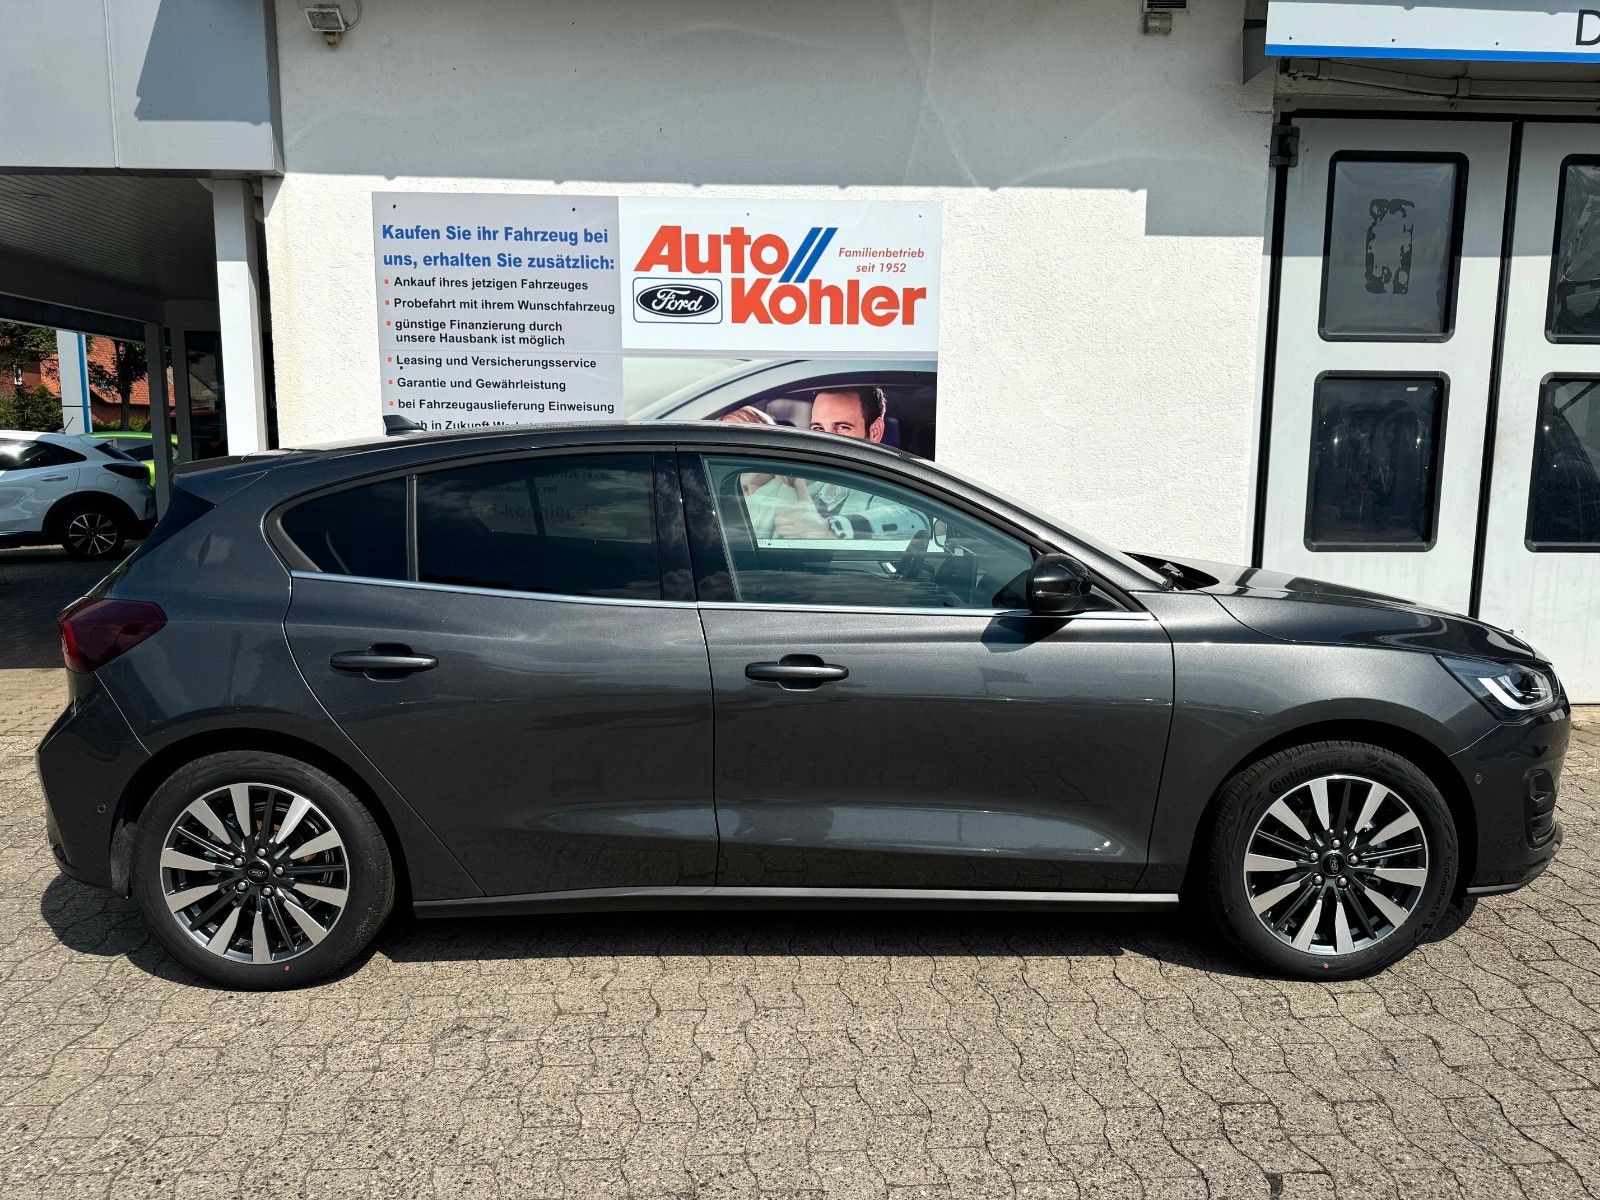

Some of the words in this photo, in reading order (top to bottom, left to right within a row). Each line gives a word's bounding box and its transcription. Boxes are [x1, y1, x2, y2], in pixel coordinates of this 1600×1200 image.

[382, 225, 440, 239] Kaufen
[446, 226, 471, 240] Sie
[478, 226, 499, 240] ihr
[504, 227, 578, 246] Fahrzeug
[584, 229, 607, 243] bei
[633, 225, 789, 275] Auto
[838, 247, 925, 259] Familienbetrieb
[384, 255, 417, 269] uns,
[423, 252, 491, 266] erhalten
[497, 253, 522, 267] Sie
[528, 255, 614, 269] zusätzlich:
[856, 262, 876, 273] seit
[879, 263, 907, 274] 1952
[394, 277, 435, 286] Ankauf
[440, 277, 468, 287] ihres
[472, 278, 517, 290] jetzigen
[521, 279, 588, 292] Fahrzeuges
[394, 298, 456, 308] Probefahrt
[460, 299, 477, 309] mit
[482, 300, 514, 309] ihrem
[518, 300, 614, 314] Wunschfahrzeug
[651, 287, 703, 312] Ford
[395, 319, 446, 331] günstige
[450, 320, 525, 333] Finanzierung
[529, 321, 562, 331] durch
[396, 334, 435, 343] unsere
[440, 333, 497, 343] Hausbank
[502, 334, 515, 344] ist
[519, 335, 564, 347] möglich
[397, 355, 442, 368] Leasing
[446, 356, 467, 365] und
[472, 356, 596, 369] Versicherungsservice
[397, 378, 446, 387] Garantie
[451, 379, 471, 388] und
[476, 379, 565, 392] Gewährleistung
[399, 399, 415, 408] bei
[420, 399, 544, 412] Fahrzeugauslieferung
[549, 402, 614, 414] Einweisung
